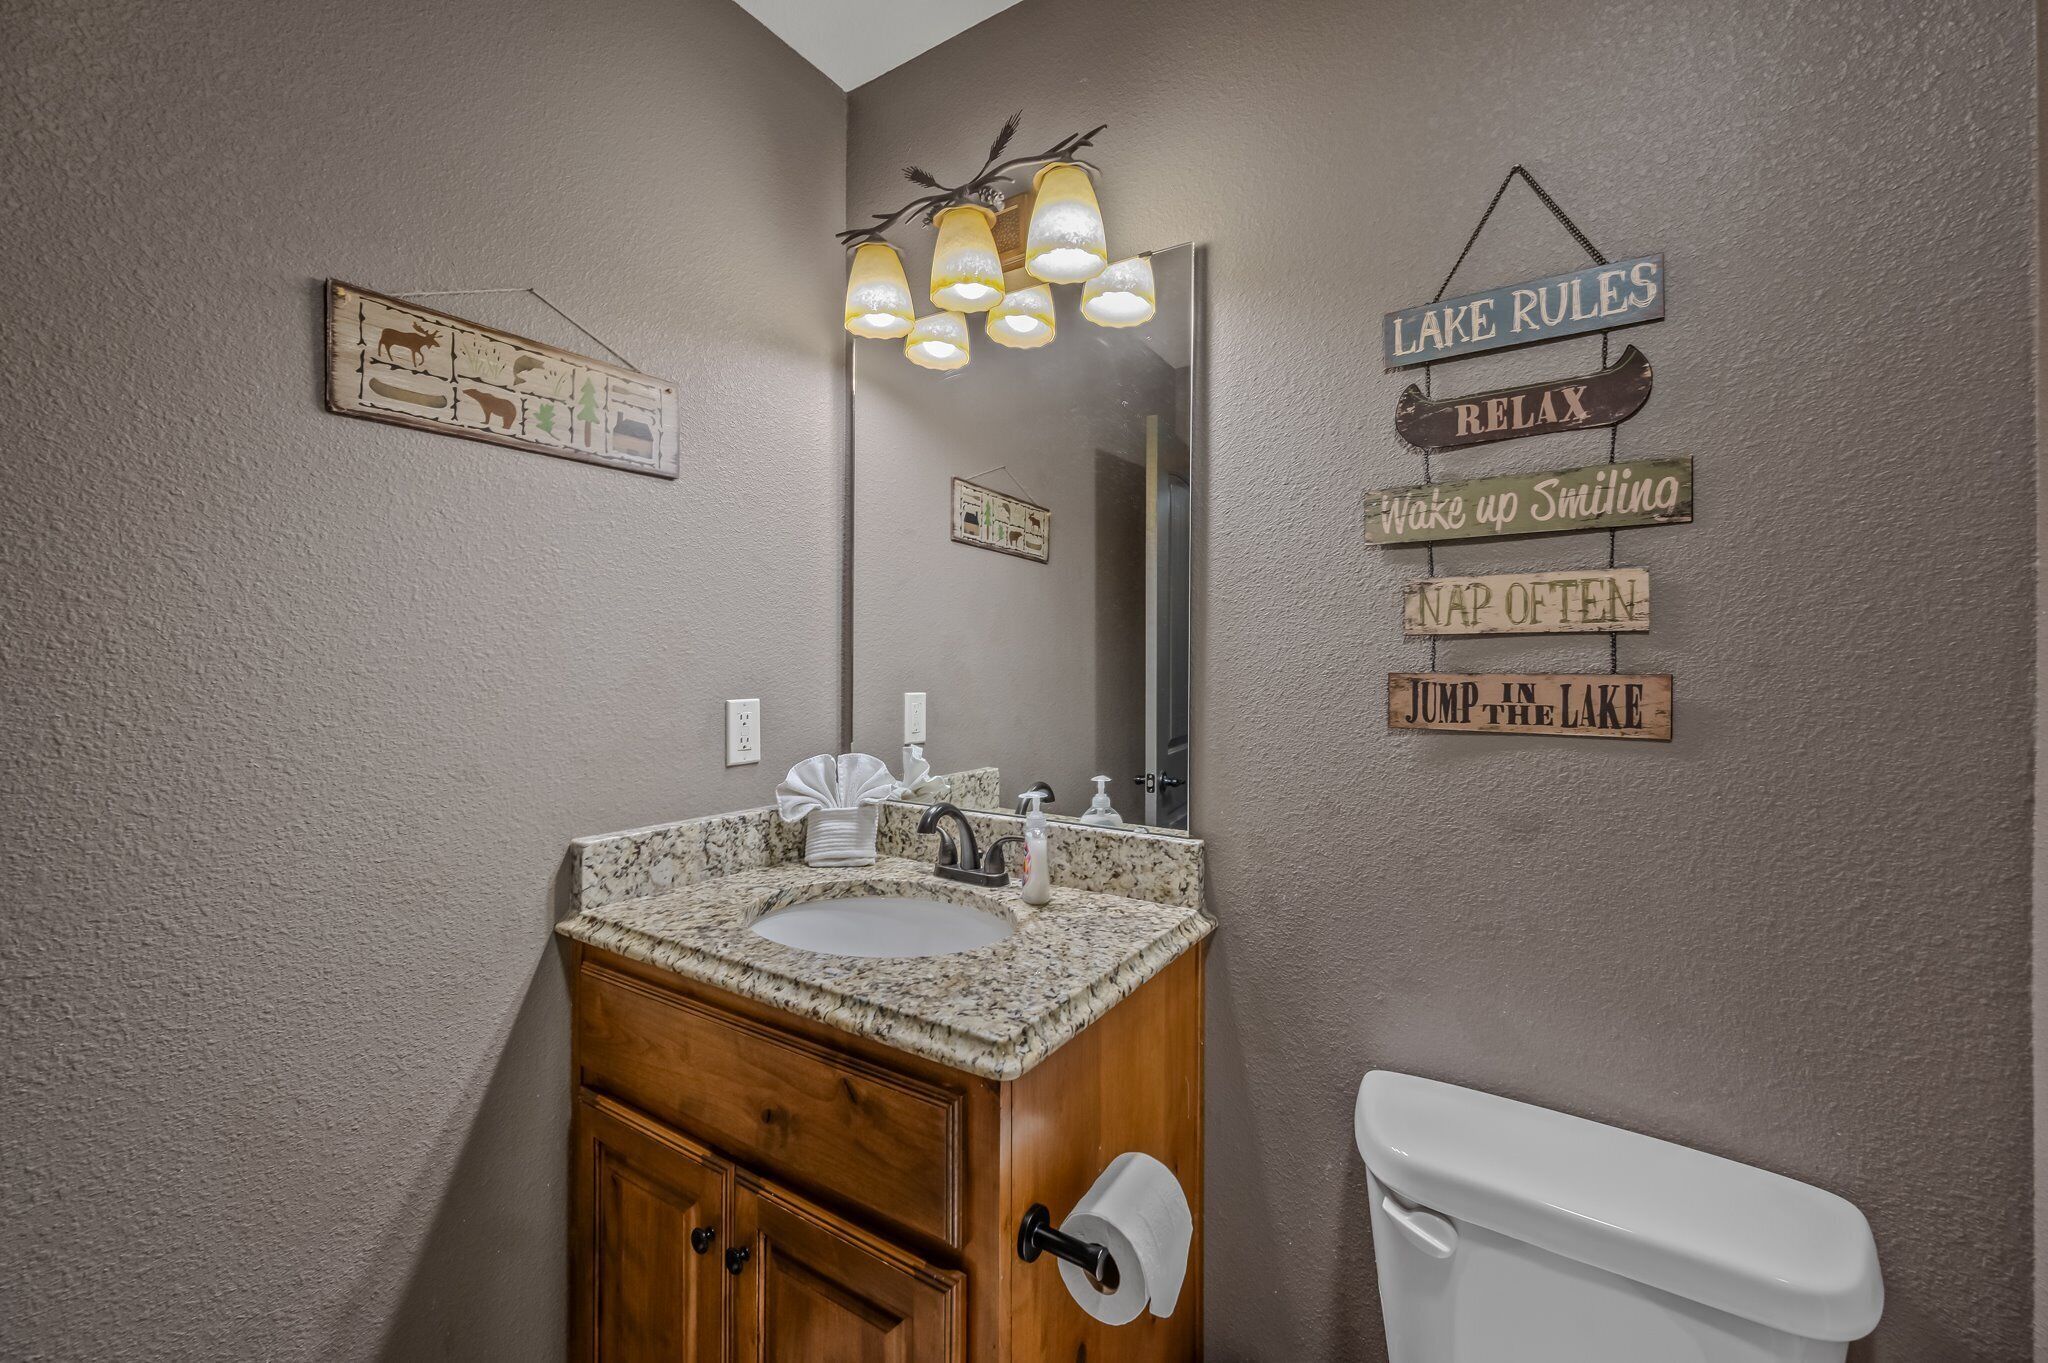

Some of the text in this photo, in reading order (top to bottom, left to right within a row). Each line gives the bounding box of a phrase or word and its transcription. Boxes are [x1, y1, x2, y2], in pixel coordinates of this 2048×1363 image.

[1392, 262, 1658, 357] LAKE RULES
[1455, 386, 1591, 437] RELAX
[1381, 468, 1680, 534] Wake up Smiling
[1417, 577, 1636, 627] NAP OFTEN
[1405, 679, 1643, 729] JUMP IN THE LAKE
